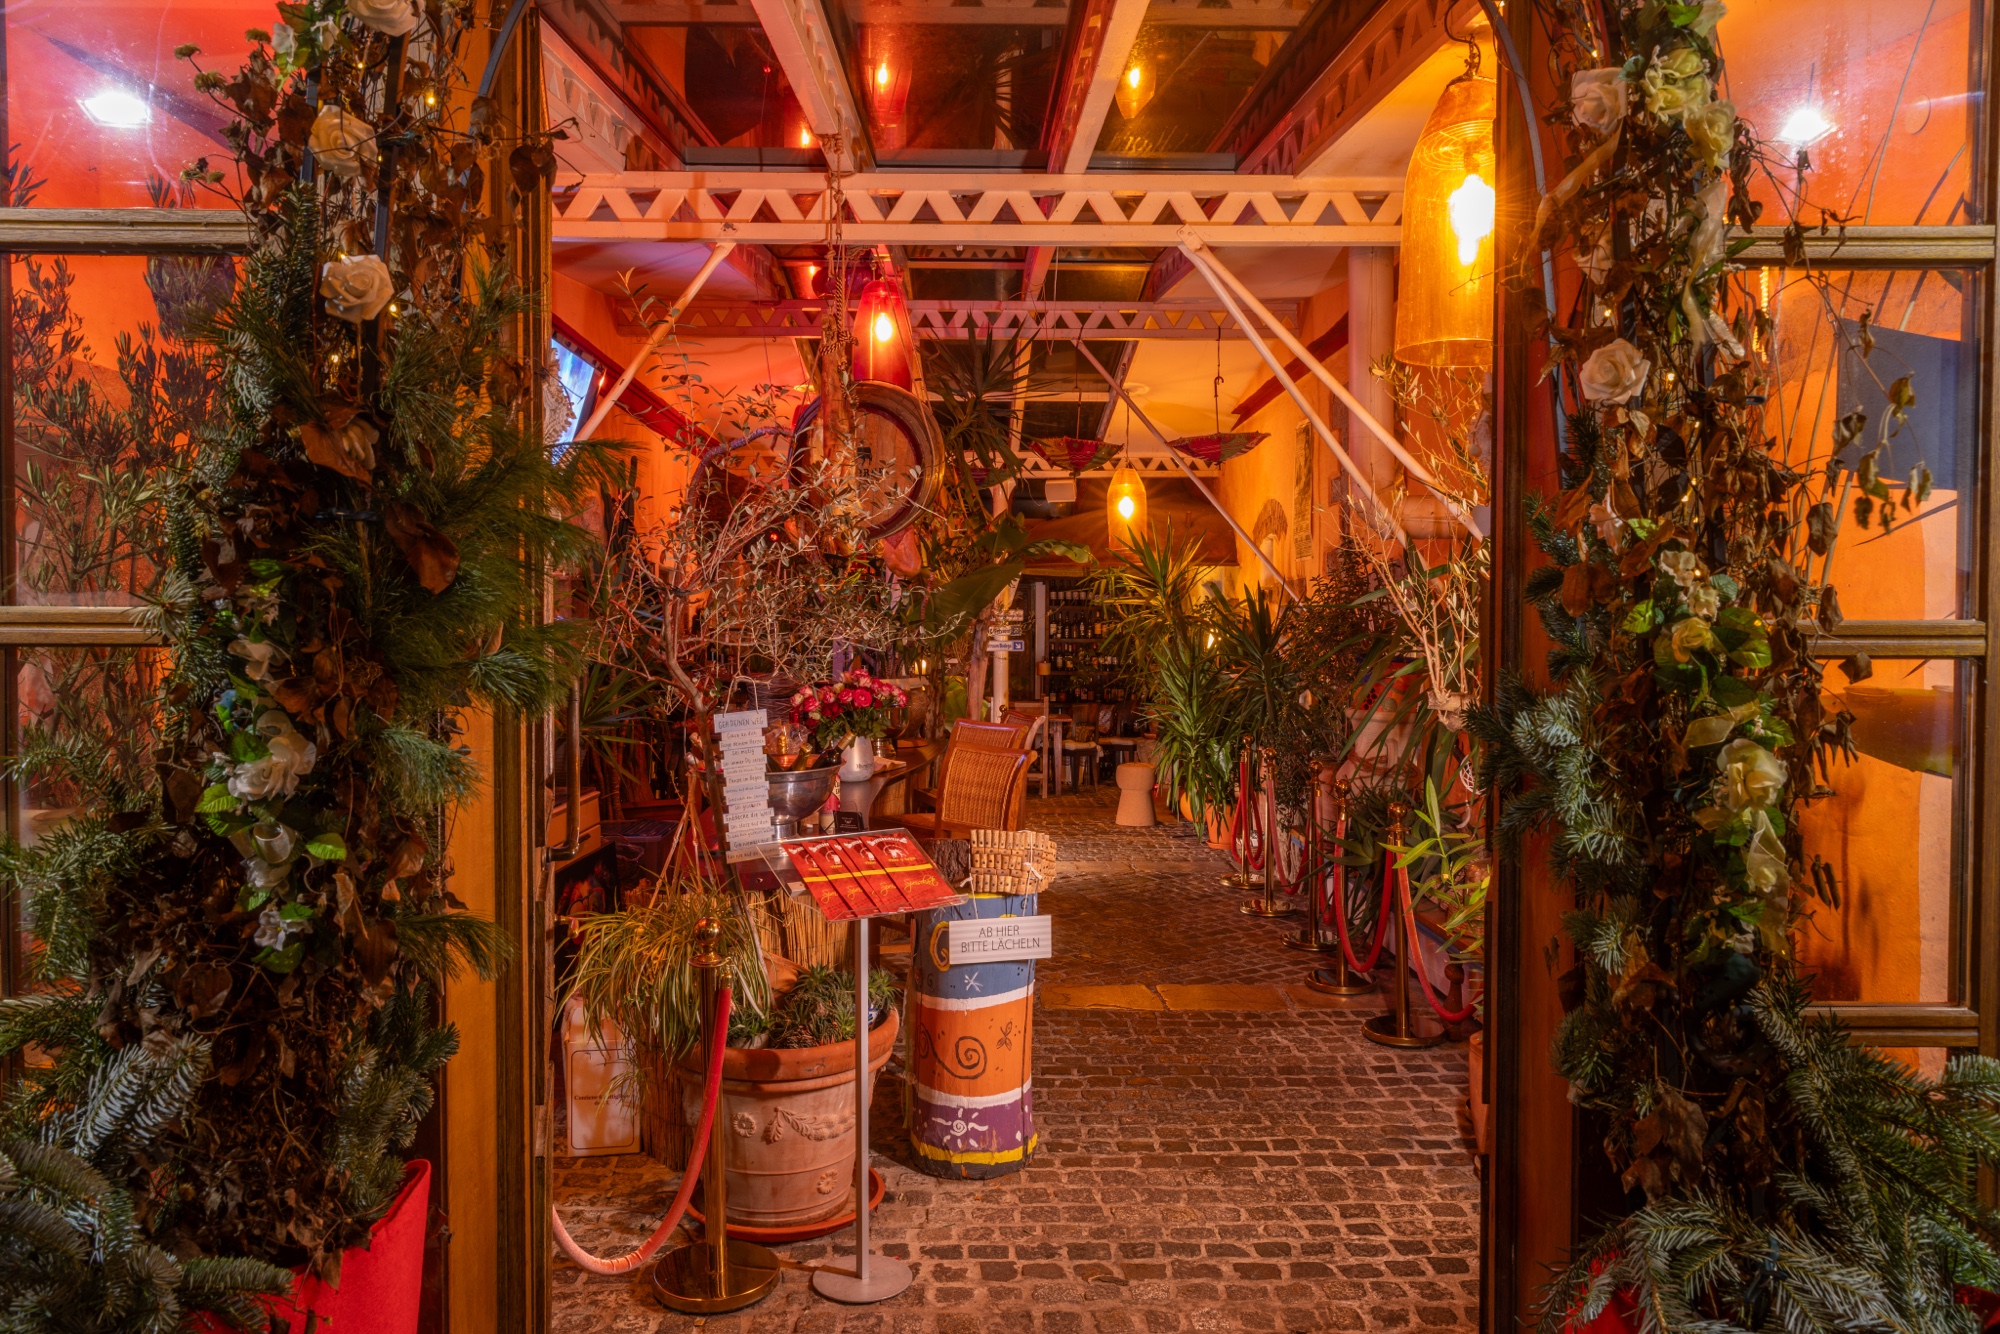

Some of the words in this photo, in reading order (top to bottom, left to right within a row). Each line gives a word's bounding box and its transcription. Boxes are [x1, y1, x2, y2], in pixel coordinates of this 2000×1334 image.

[730, 719, 750, 727] DEINEN
[751, 717, 763, 725] WEG
[978, 926, 993, 938] AB
[996, 924, 1020, 937] HIER
[961, 940, 988, 953] BITTE
[991, 937, 1040, 951] LÄCHELN
